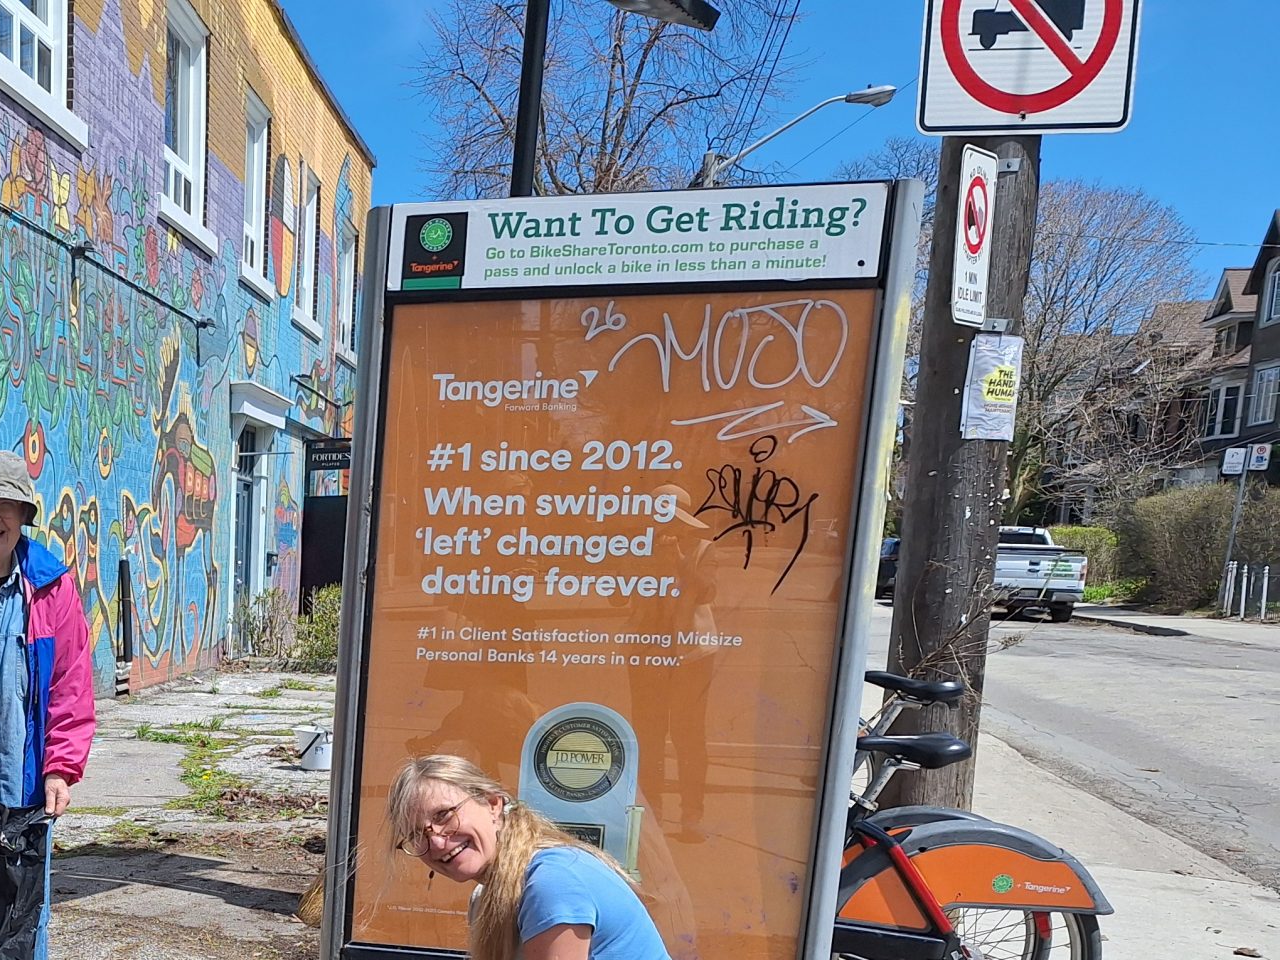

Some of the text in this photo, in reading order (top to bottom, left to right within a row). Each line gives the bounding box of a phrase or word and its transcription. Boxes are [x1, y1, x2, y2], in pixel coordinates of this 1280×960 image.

[487, 196, 868, 239] Want To Get Riding?
[485, 238, 819, 260] Go to BikeShareToronto.com to purchase a
[410, 261, 454, 274] Tangerine
[484, 255, 827, 281] pass and unlock a bike in less than a minute!
[581, 300, 627, 341] 26
[998, 370, 1014, 379] THE
[432, 371, 580, 407] Tangerine
[504, 402, 578, 412] Forward Banking
[427, 440, 683, 472] #1 since 2012.
[424, 485, 678, 523] When swiping
[496, 527, 655, 564] changed
[421, 566, 681, 603] dating forever.
[416, 626, 744, 647] #1 in Client Satisfaction among Midsize
[415, 648, 483, 663] Personal
[487, 648, 535, 663] Banks
[539, 650, 558, 664] 14
[561, 651, 607, 667] years
[610, 651, 626, 666] in
[629, 654, 640, 667] a
[570, 753, 605, 764] POWER
[1024, 881, 1066, 894] Tangerine
